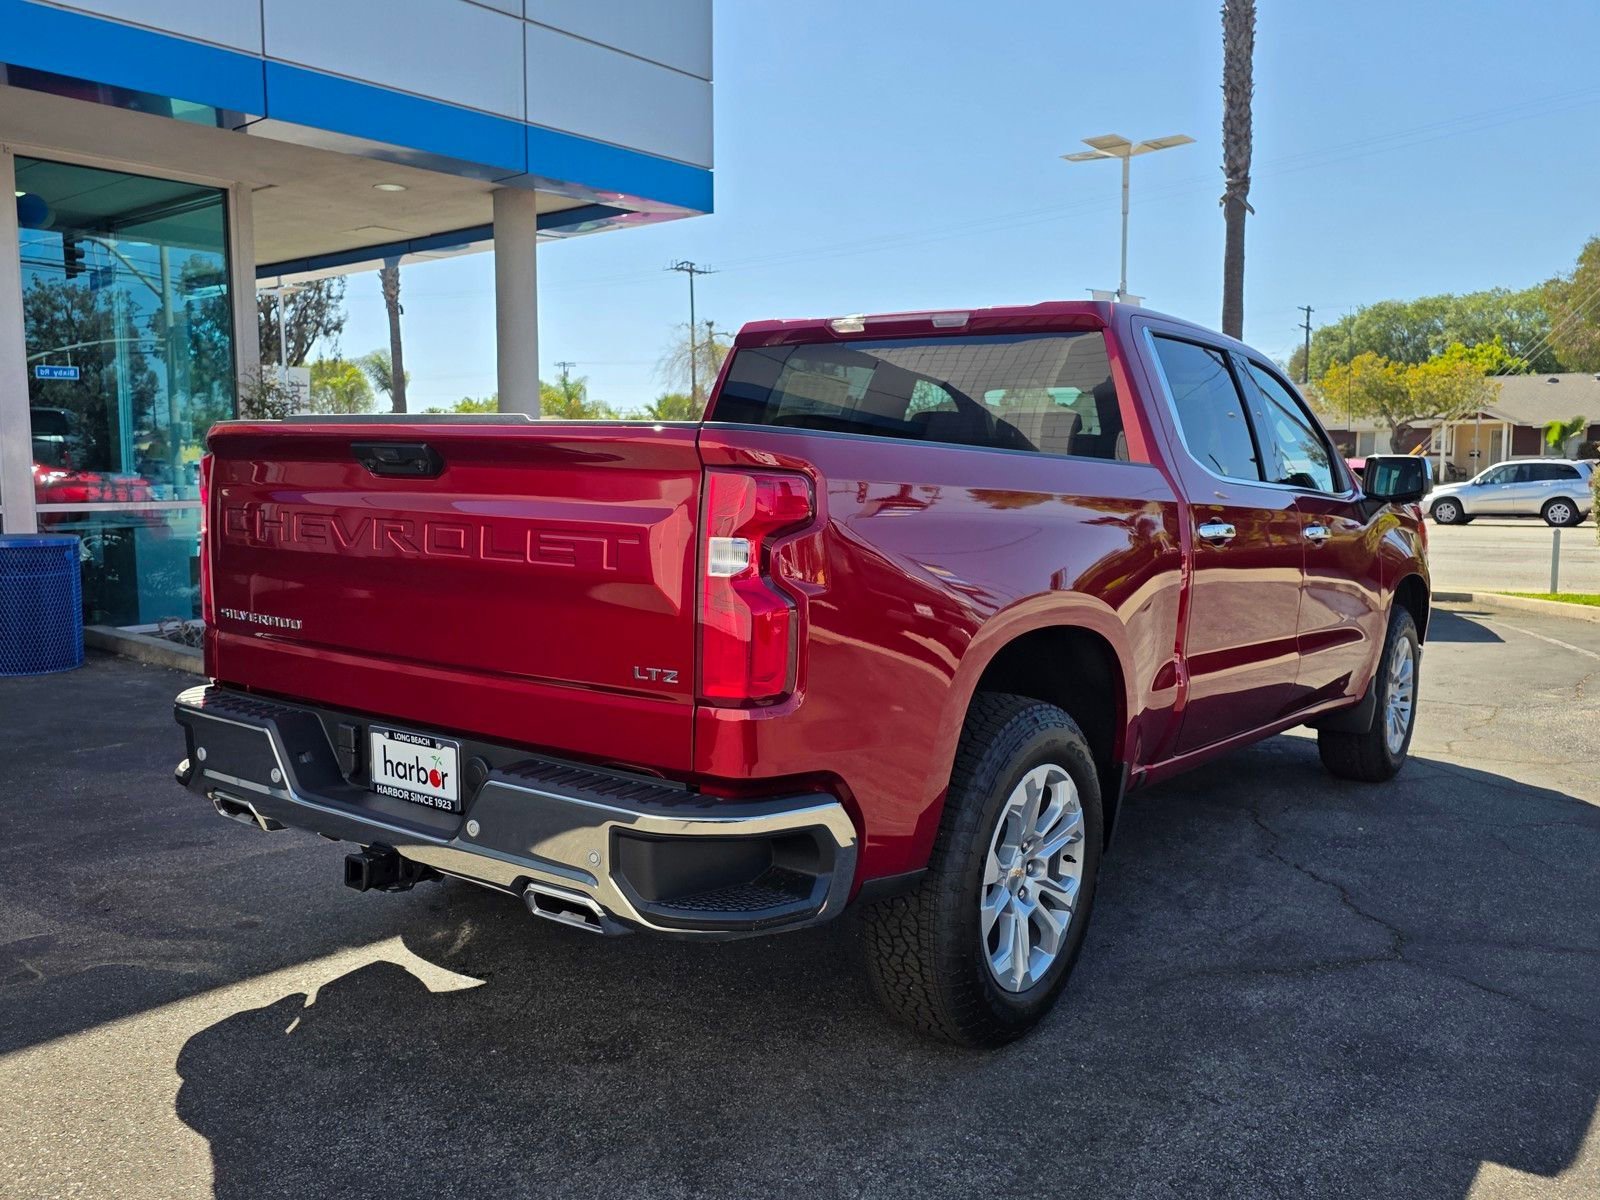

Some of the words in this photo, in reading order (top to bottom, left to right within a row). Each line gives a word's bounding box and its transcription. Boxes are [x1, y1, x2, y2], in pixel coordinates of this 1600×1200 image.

[225, 506, 640, 571] CHEVROLET
[634, 666, 679, 683] LTZ
[393, 732, 411, 742] LONG
[411, 736, 430, 746] BEACH
[383, 745, 448, 789] harbor
[376, 785, 409, 800] HARBOR
[410, 793, 433, 805] SINCE
[434, 798, 452, 810] 1923
